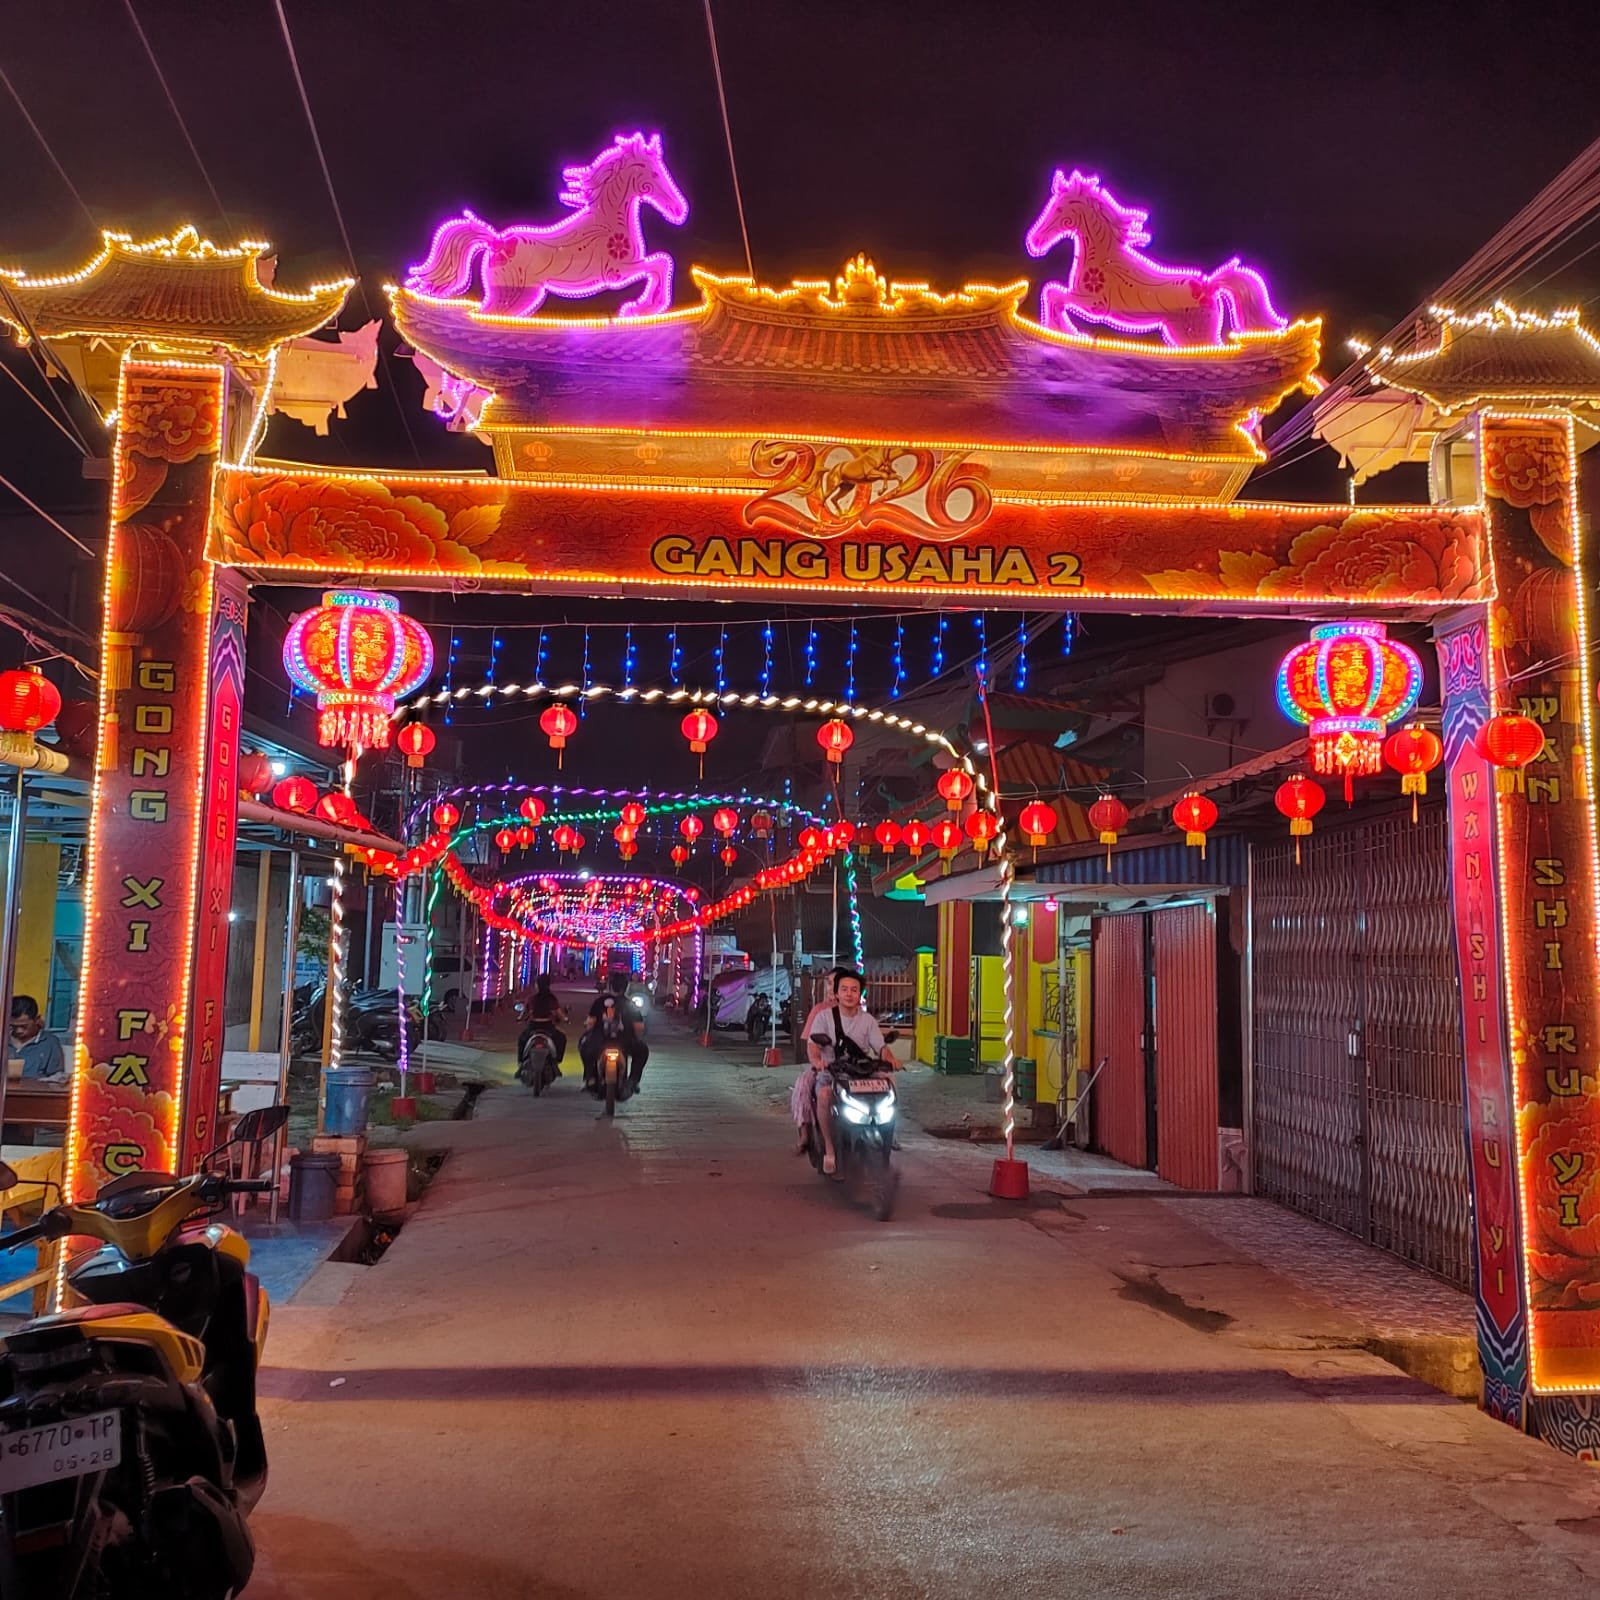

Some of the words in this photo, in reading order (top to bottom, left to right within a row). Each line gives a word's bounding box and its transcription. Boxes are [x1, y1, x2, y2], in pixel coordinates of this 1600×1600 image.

[743, 439, 993, 541] 2026
[652, 536, 828, 579] GANG
[842, 544, 1037, 585] USAHA
[1047, 552, 1083, 586] 2
[130, 661, 175, 822] GONG
[216, 703, 232, 841] GONG
[1461, 771, 1480, 880] WAN
[120, 876, 164, 952] XI
[210, 888, 223, 952] XI
[1533, 856, 1568, 969] SHI
[1470, 933, 1487, 1043] SHI
[107, 1009, 149, 1086] FA
[201, 1000, 215, 1065] FA
[1544, 1024, 1582, 1096] RU
[102, 1143, 144, 1174] C
[1482, 1096, 1500, 1168] RU
[18, 1425, 71, 1457] 6770
[89, 1415, 114, 1441] TP
